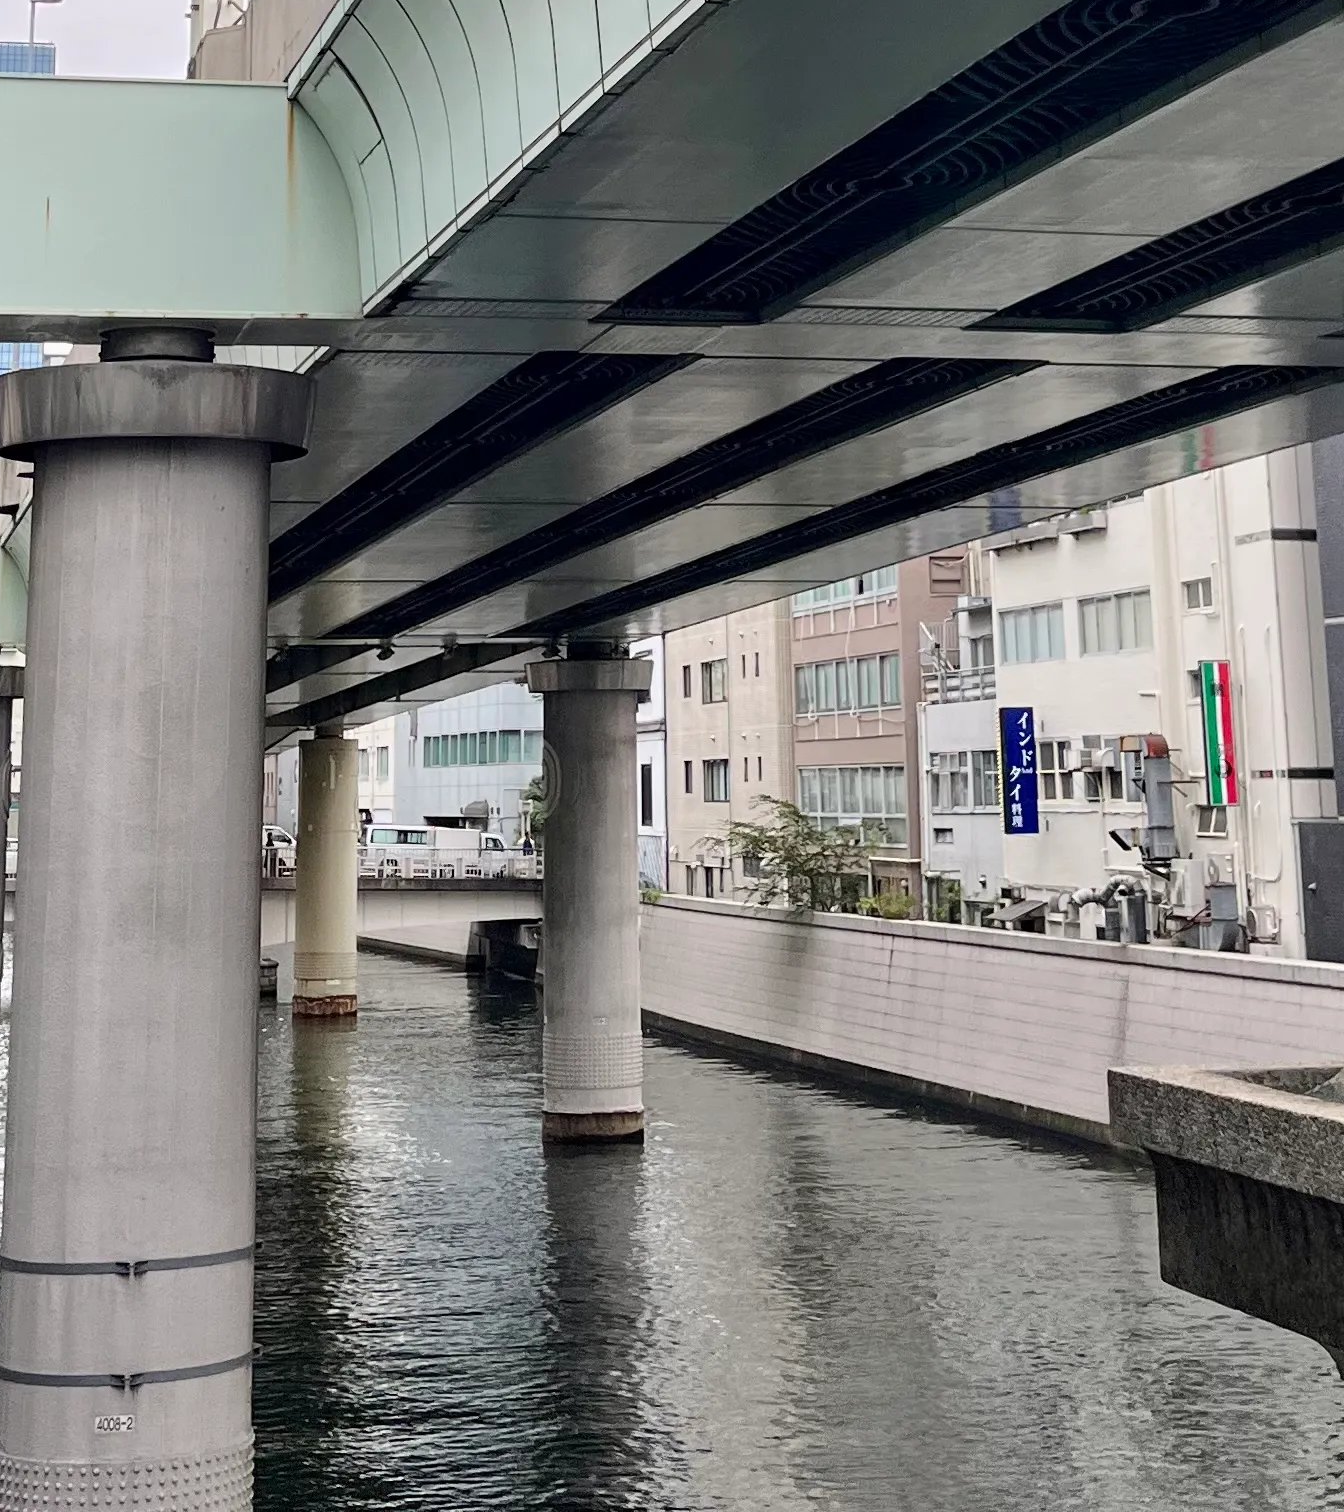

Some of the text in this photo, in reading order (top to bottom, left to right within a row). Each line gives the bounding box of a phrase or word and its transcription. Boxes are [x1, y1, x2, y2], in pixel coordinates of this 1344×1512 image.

[1017, 712, 1033, 766] インド
[96, 1417, 133, 1431] 4008-2
